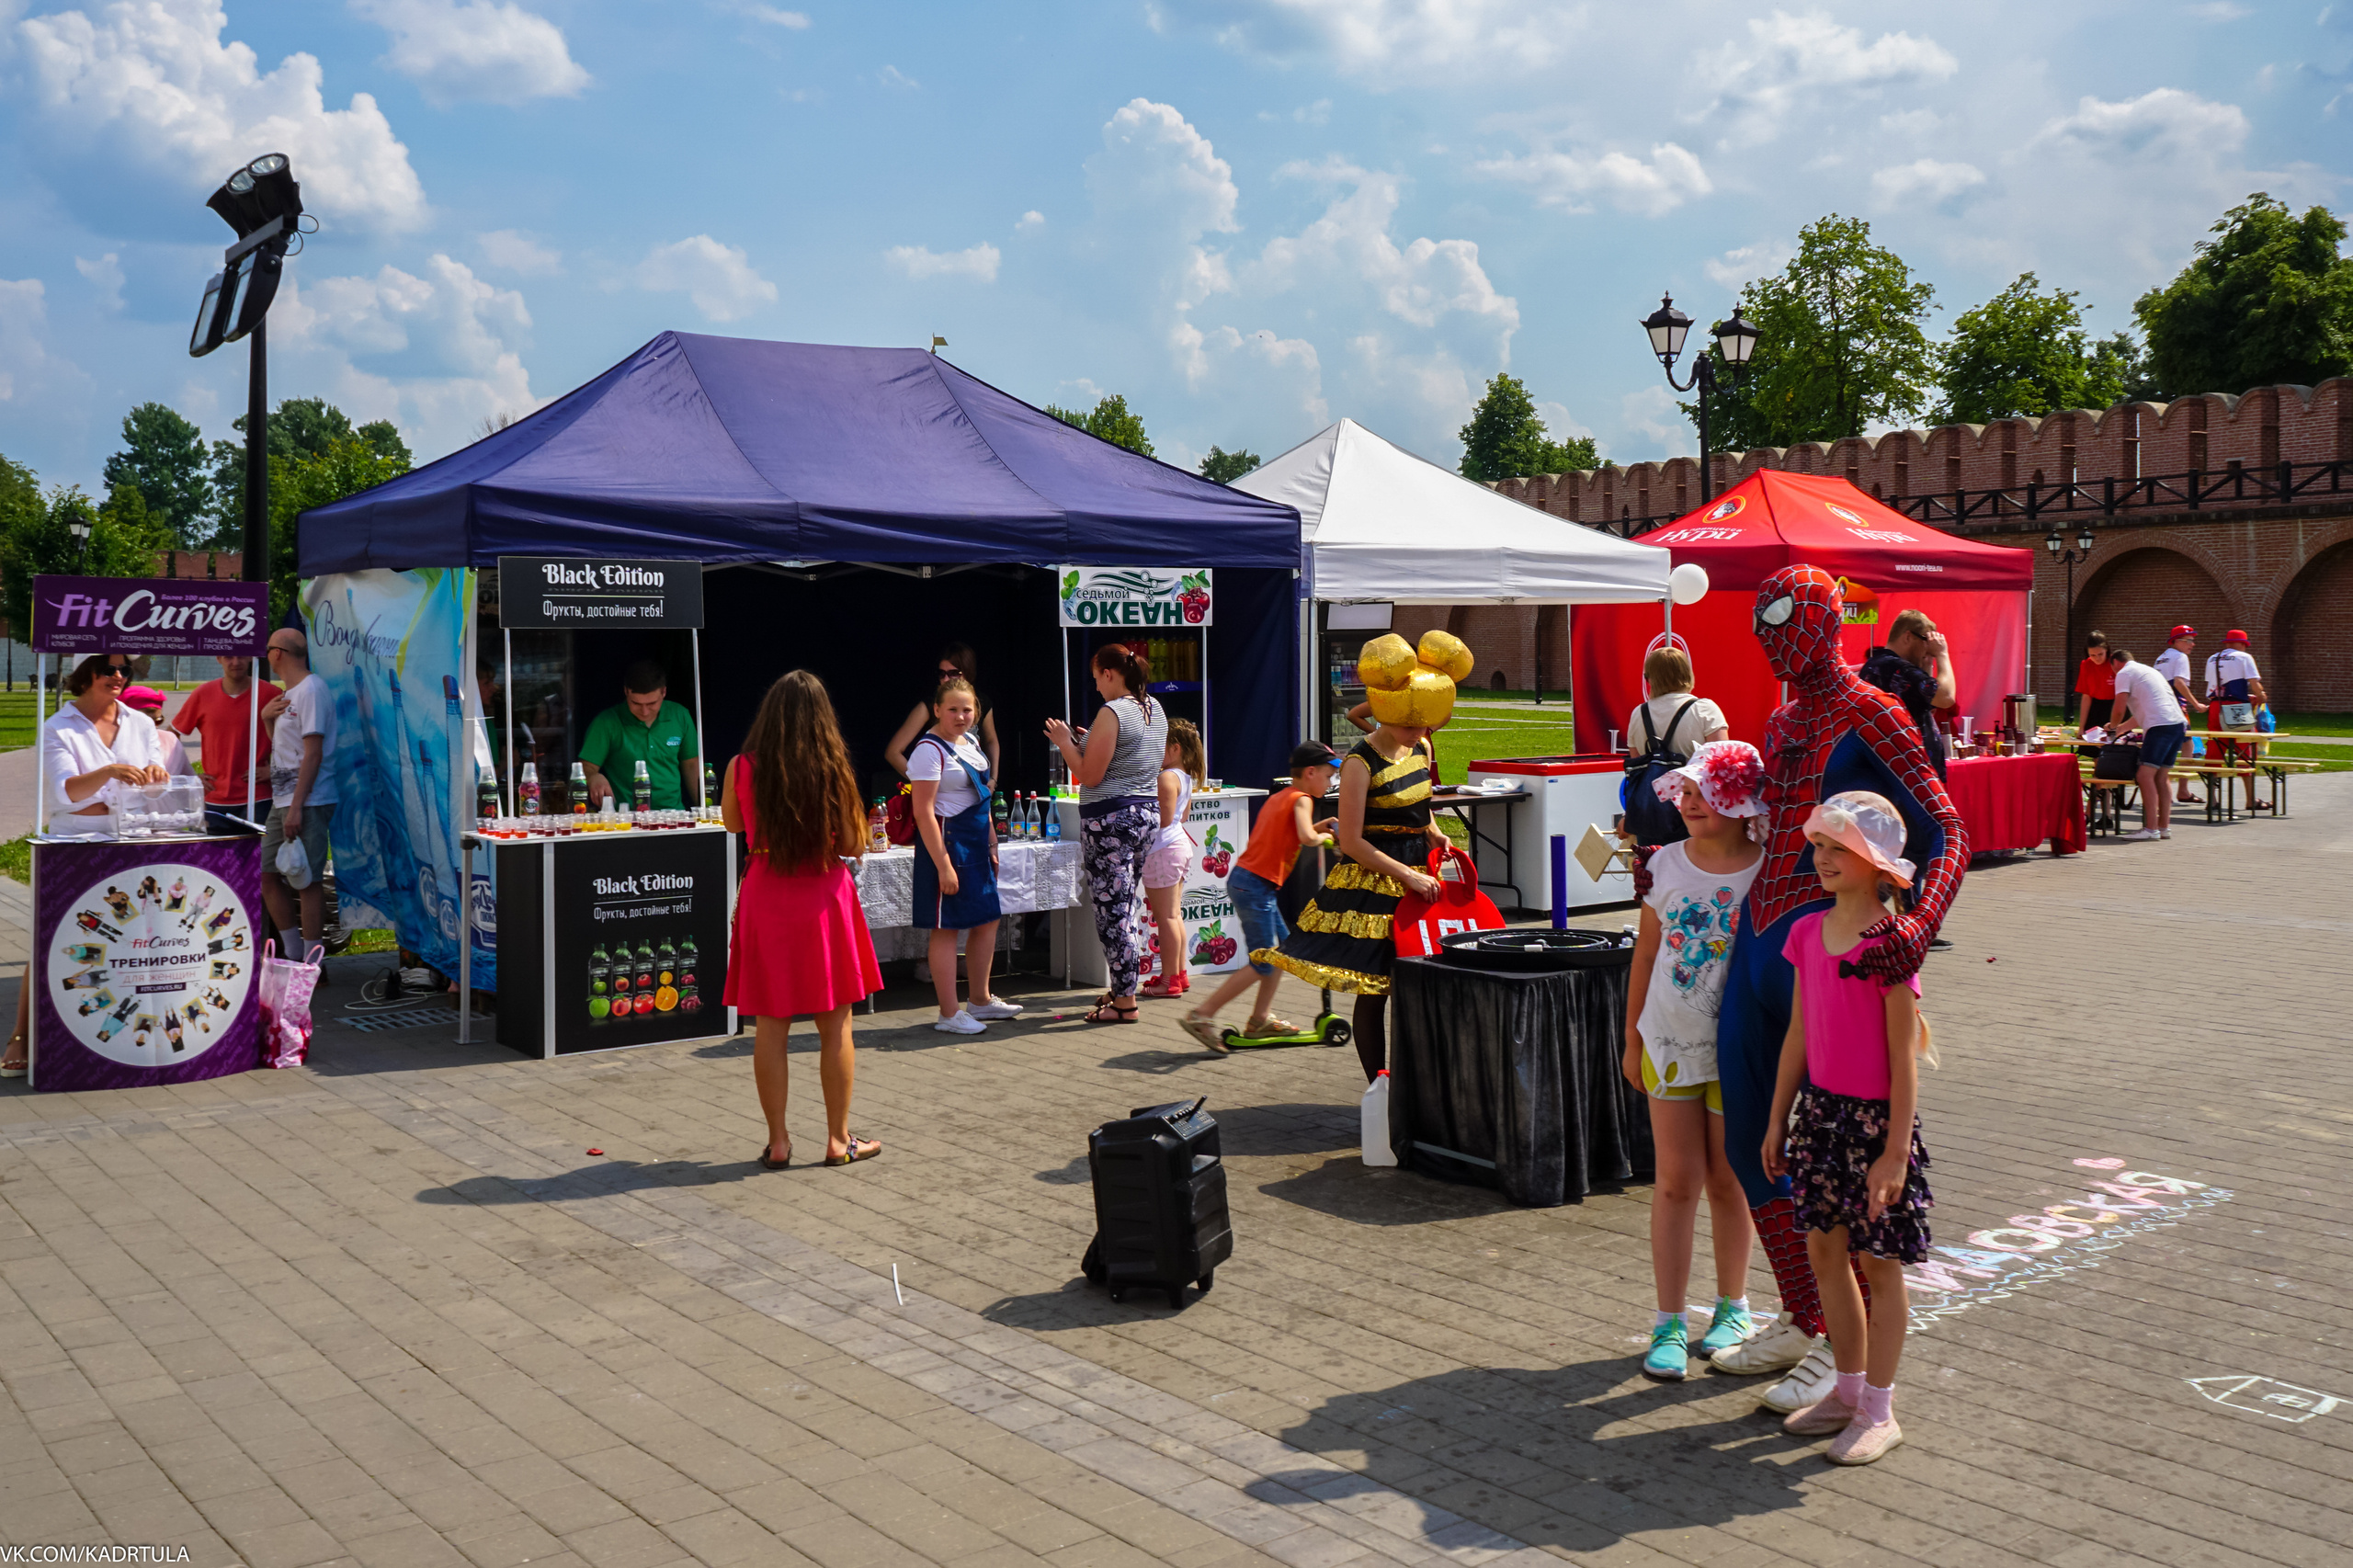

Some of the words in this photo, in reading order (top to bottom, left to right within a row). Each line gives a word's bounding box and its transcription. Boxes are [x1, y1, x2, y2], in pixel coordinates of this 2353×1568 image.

[541, 563, 601, 589] Black
[600, 565, 665, 587] Edition
[1075, 589, 1130, 601] седьмой
[543, 599, 585, 620] Фрукты,
[586, 604, 637, 619] достойные
[640, 599, 664, 618] тебя!
[1076, 601, 1183, 625] ОКЕАН
[1187, 812, 1230, 822] ПИТКОВ
[593, 876, 641, 895] Black
[640, 873, 694, 891] Edition
[594, 907, 627, 924] Фрукты,
[630, 904, 669, 918] достойные
[672, 898, 692, 914] тебя!
[108, 952, 207, 969] ТРЕНИРОВКИ
[123, 974, 145, 984] для
[149, 971, 197, 982] женщин
